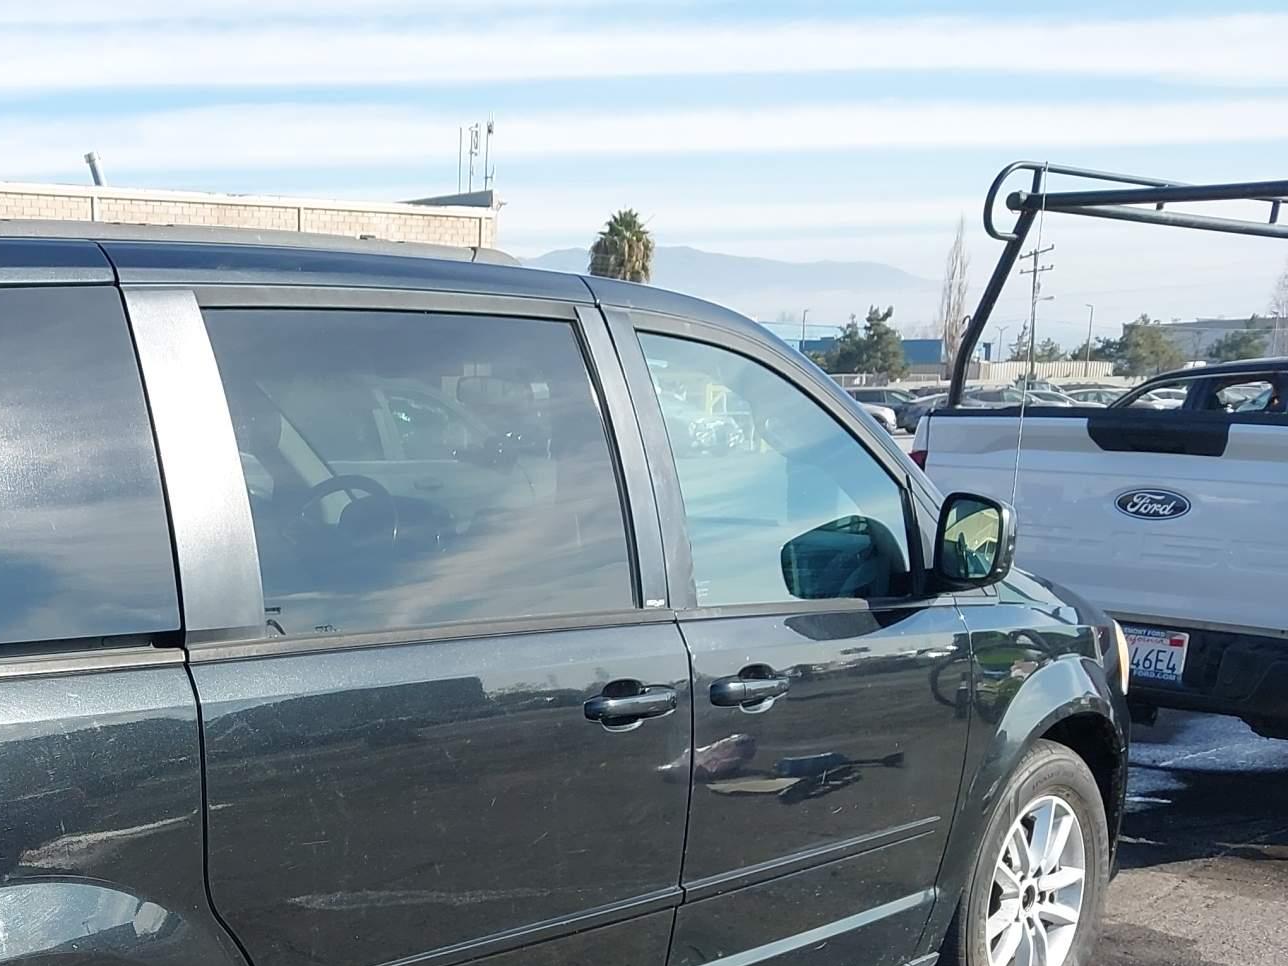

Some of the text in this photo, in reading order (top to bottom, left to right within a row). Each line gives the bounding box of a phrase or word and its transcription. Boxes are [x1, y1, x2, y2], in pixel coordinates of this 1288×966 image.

[1127, 493, 1176, 515] Ford
[1131, 647, 1177, 673] 46E4
[1133, 669, 1177, 681] FORD.COM
